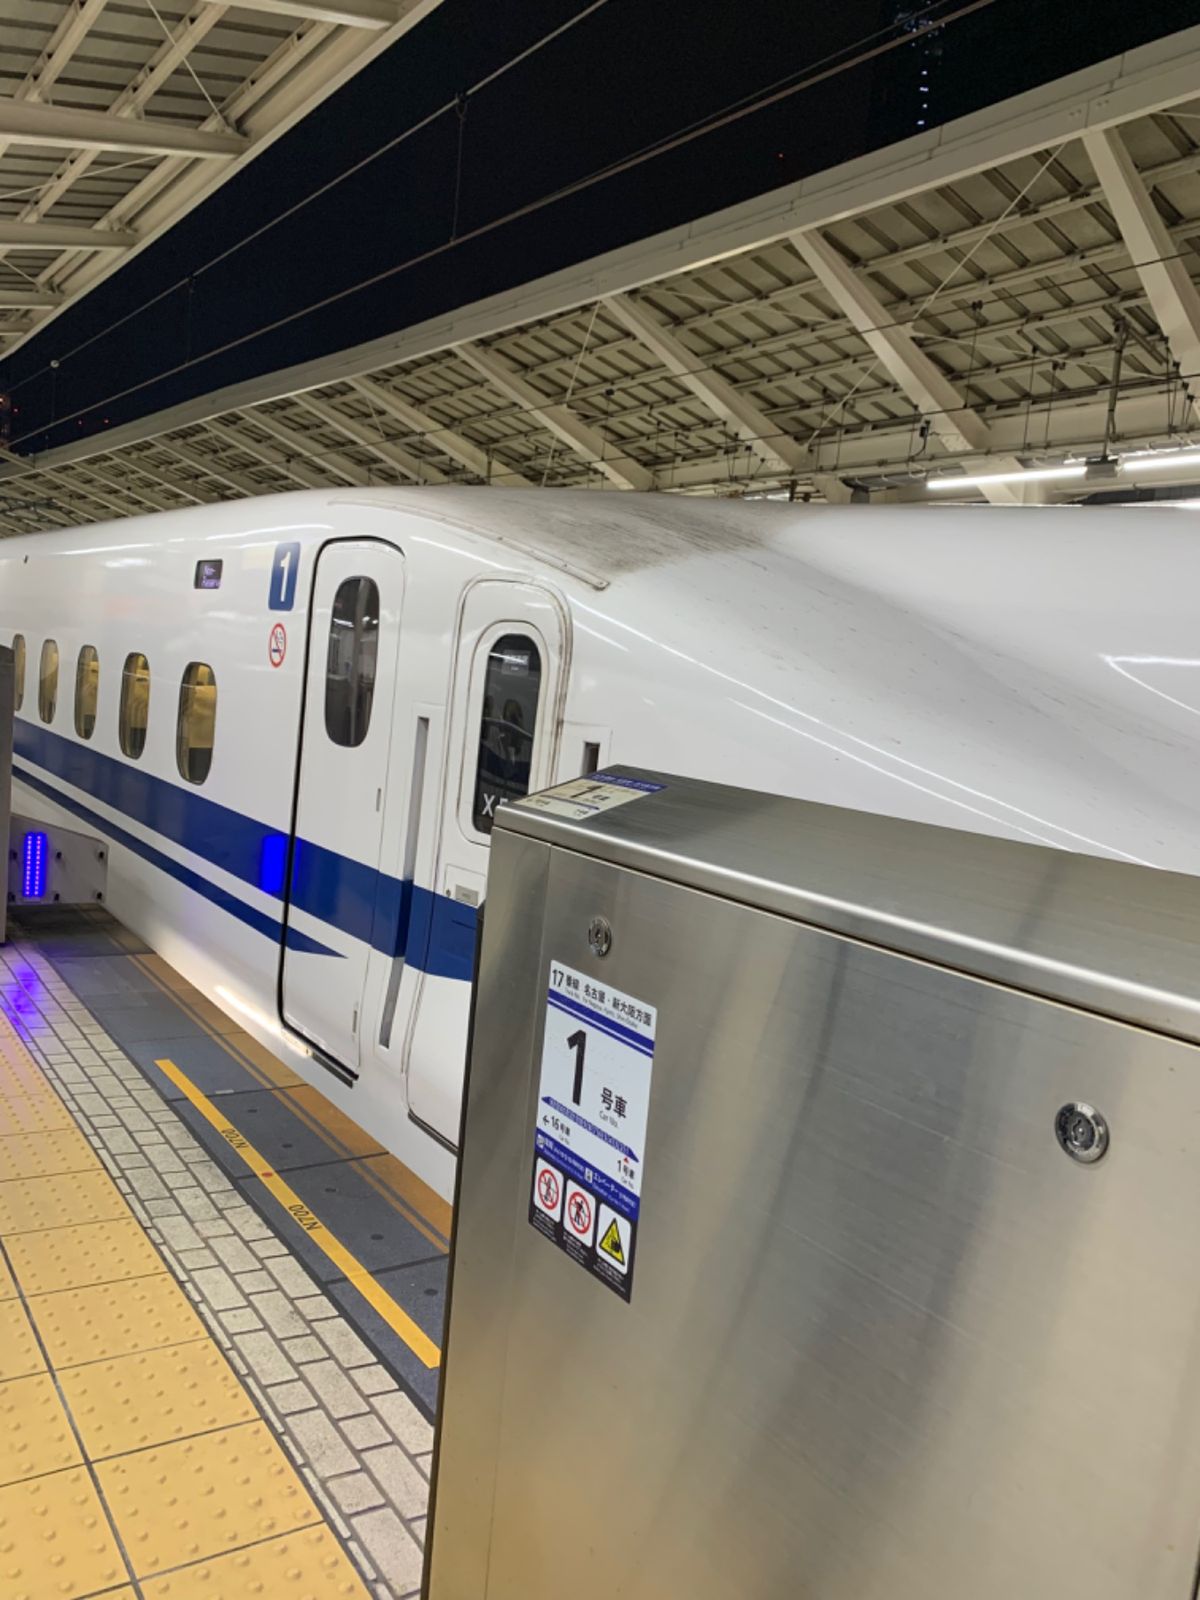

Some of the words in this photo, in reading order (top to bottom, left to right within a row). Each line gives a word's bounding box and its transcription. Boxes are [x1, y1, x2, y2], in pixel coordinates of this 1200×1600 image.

[280, 551, 291, 602] 1
[566, 1030, 587, 1106] 1
[600, 1087, 628, 1119] 号車
[288, 1204, 321, 1231] N700
